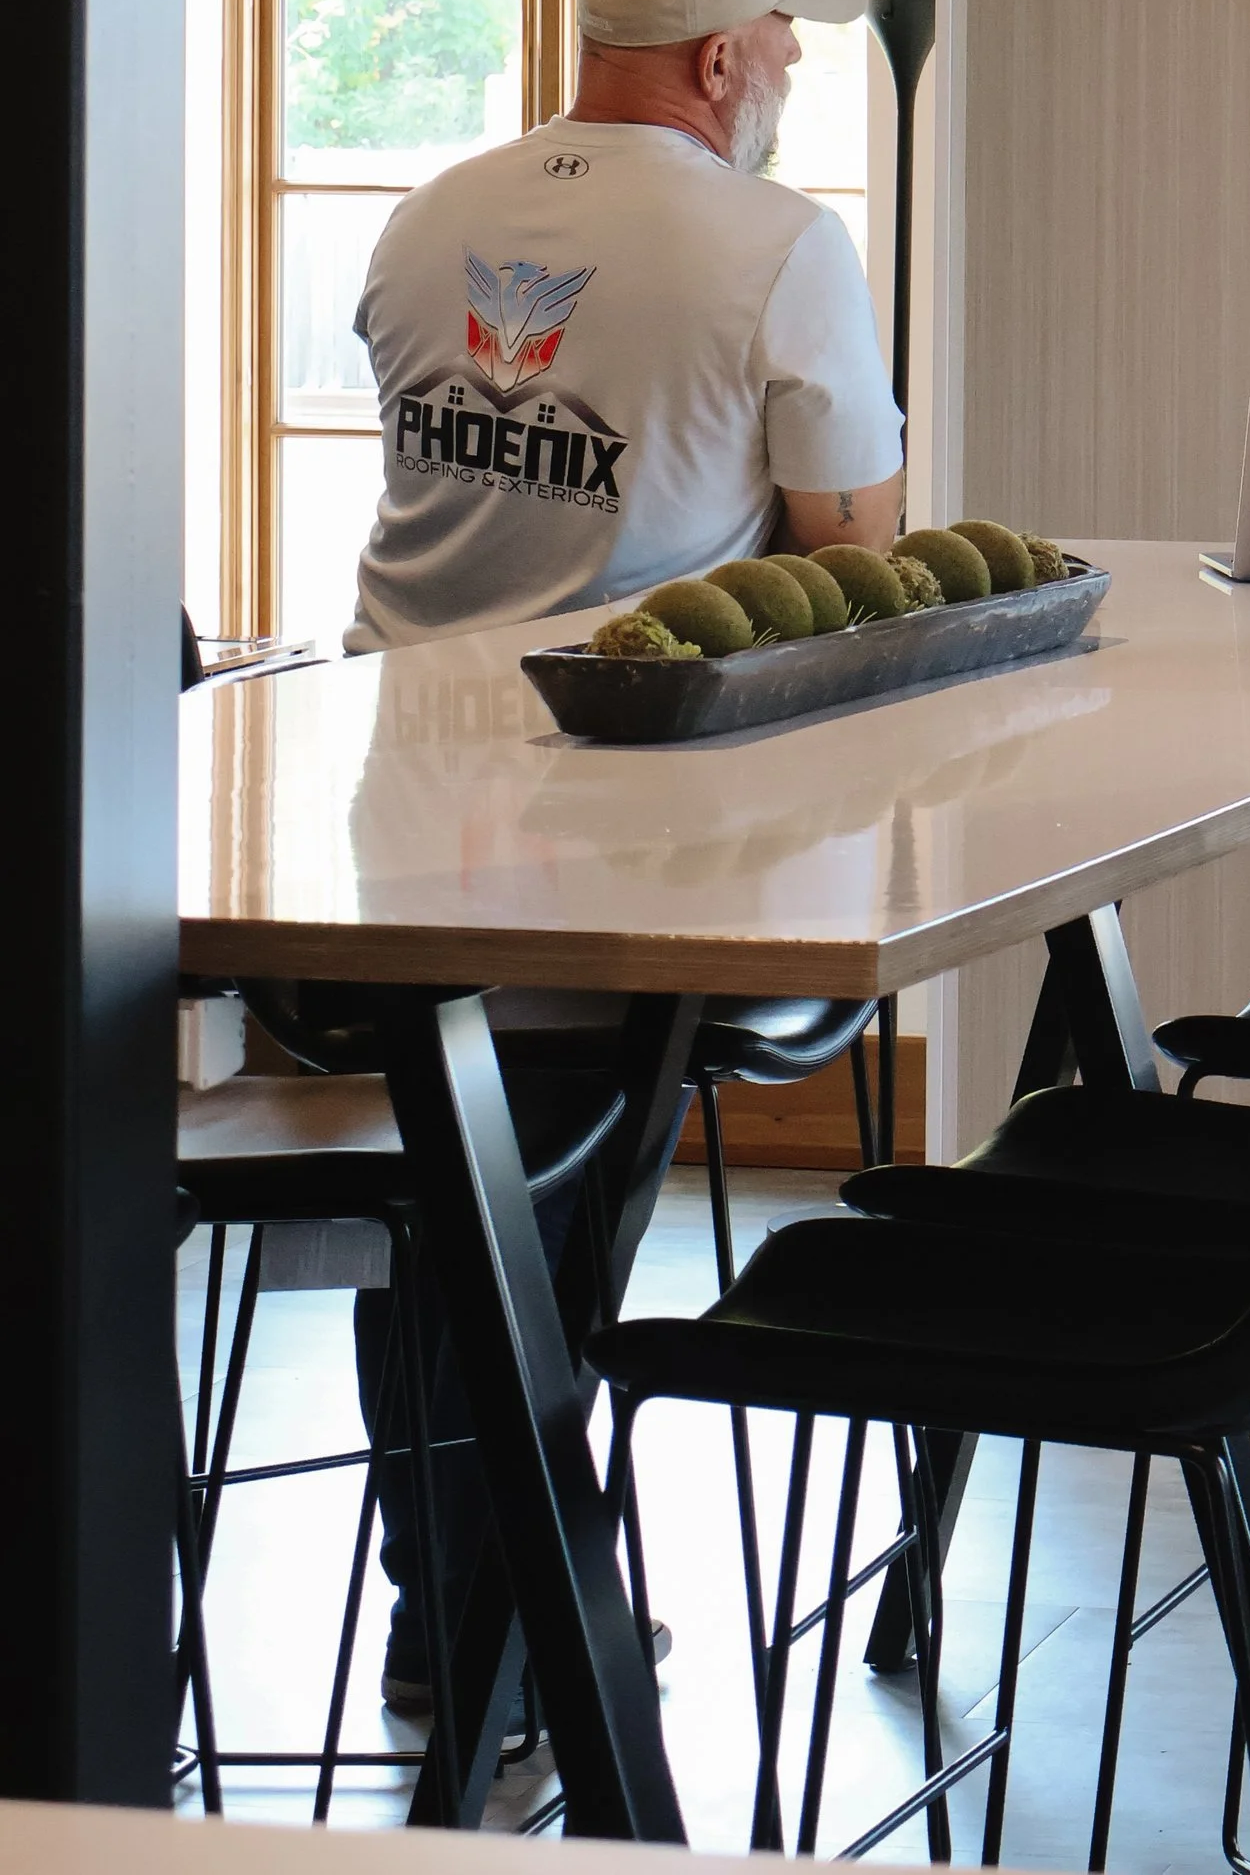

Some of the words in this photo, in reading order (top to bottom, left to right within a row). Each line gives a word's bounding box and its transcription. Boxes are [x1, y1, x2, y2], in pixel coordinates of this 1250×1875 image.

[396, 453, 475, 483] ROOFING
[481, 471, 496, 487] &
[499, 476, 620, 514] EXTERIORS
[397, 396, 628, 498] PHOENIX
